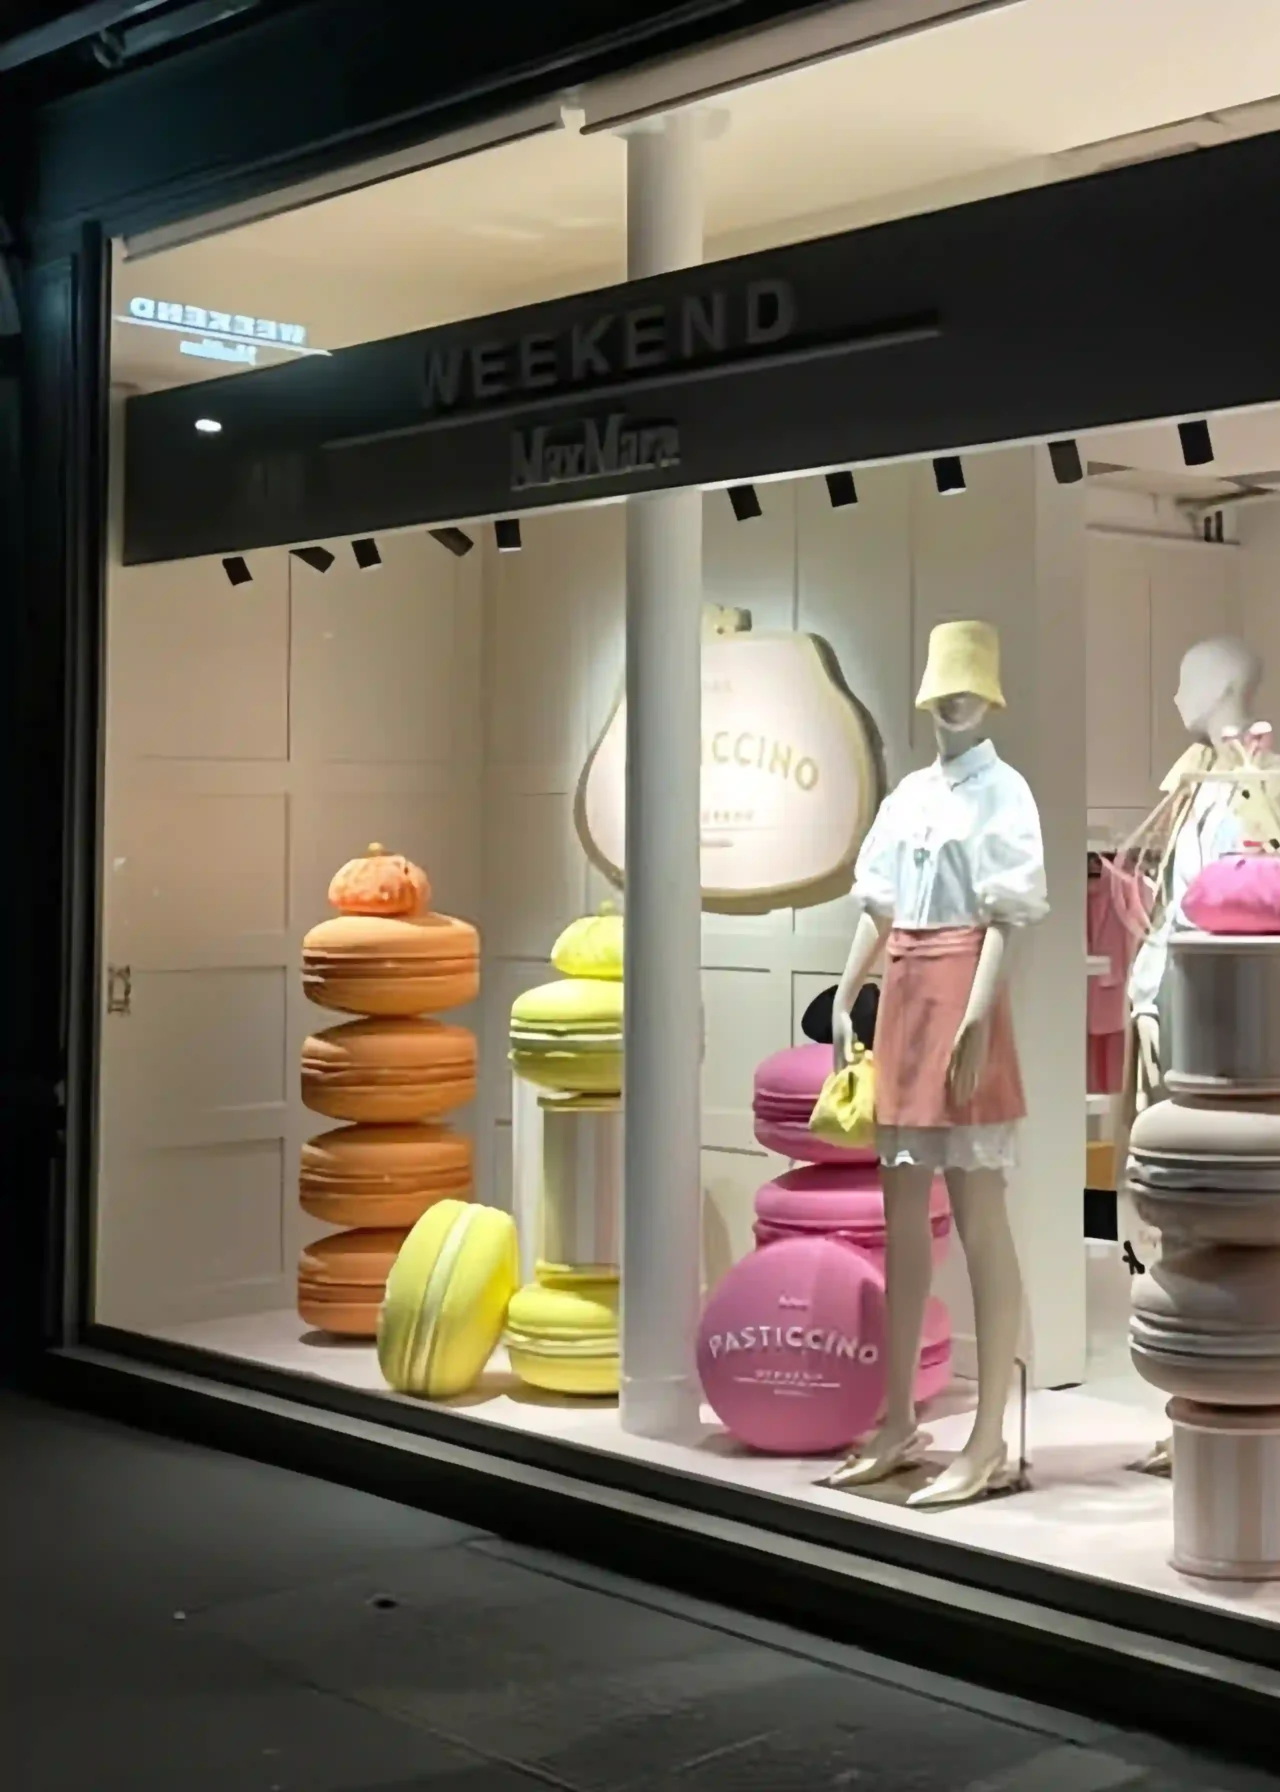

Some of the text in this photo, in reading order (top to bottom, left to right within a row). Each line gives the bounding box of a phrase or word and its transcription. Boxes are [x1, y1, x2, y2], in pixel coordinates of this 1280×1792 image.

[422, 278, 797, 408] WEEKEND
[510, 412, 682, 491] MaxMara
[701, 731, 820, 791] CCINO
[709, 1326, 879, 1365] PASTICCINO
